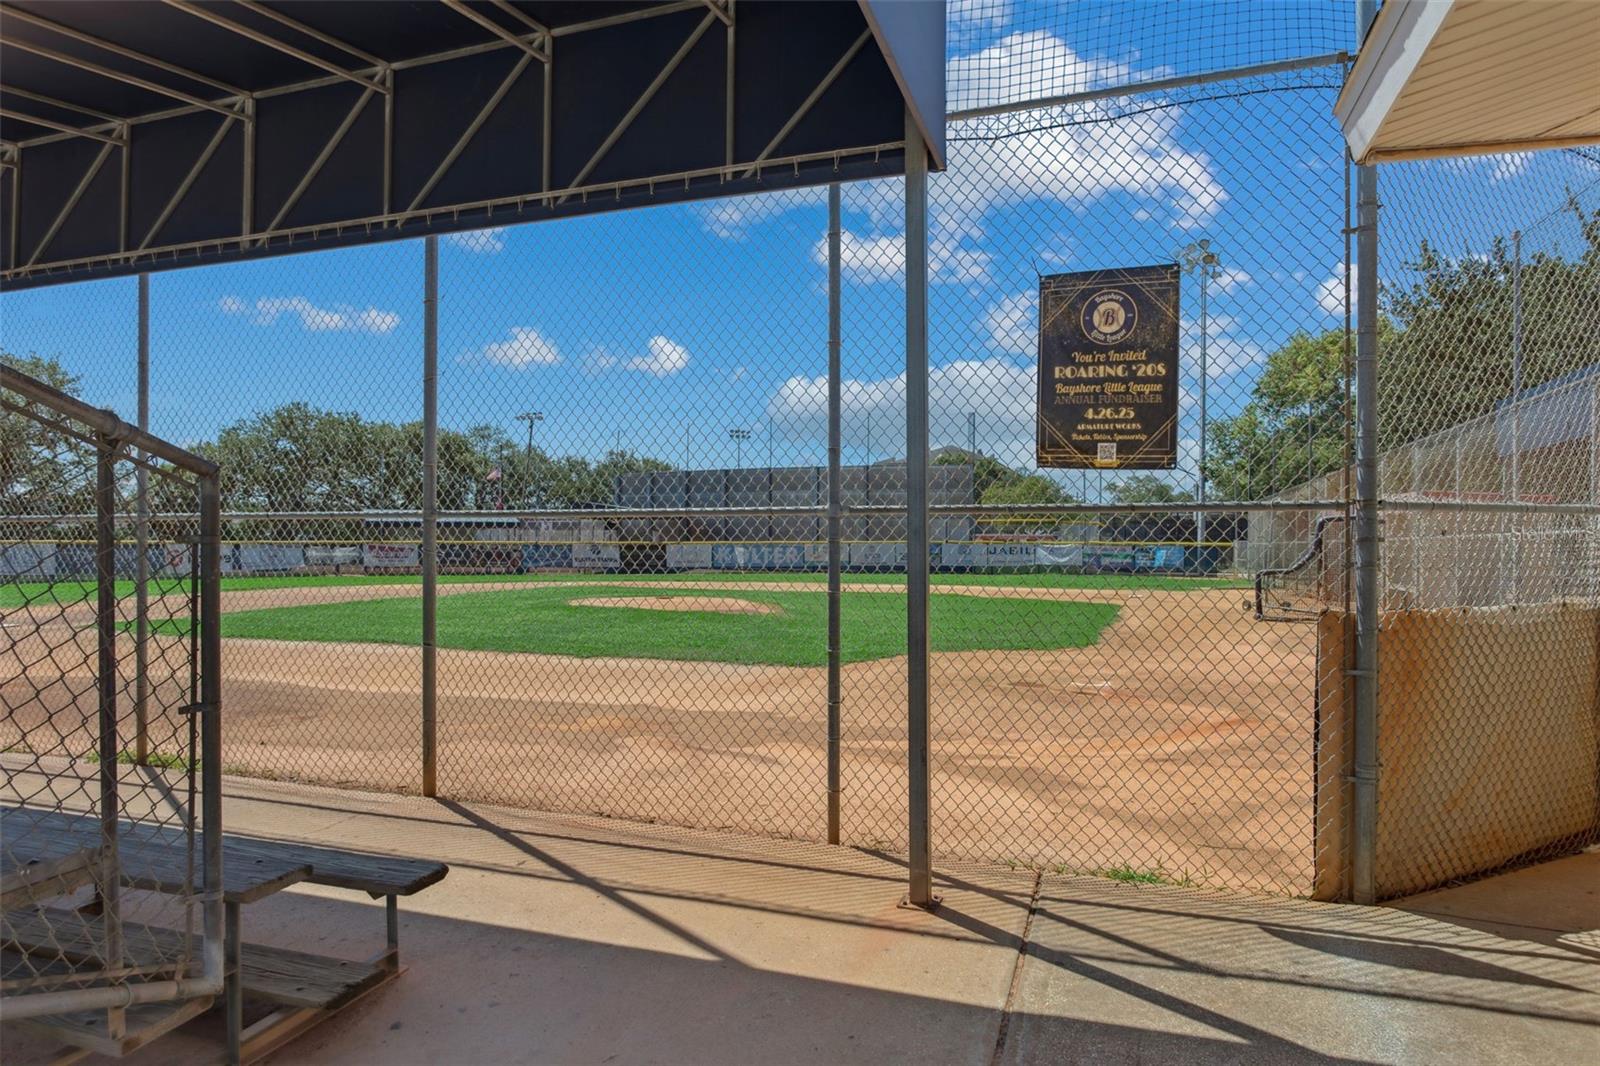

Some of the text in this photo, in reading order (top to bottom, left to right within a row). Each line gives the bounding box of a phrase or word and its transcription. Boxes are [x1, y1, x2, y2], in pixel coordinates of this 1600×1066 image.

[1103, 308, 1115, 326] B
[1071, 350, 1148, 362] You're Invited
[1055, 365, 1129, 379] ROARING
[1055, 381, 1163, 396] Bayshore Little League
[1054, 394, 1163, 405] ANNUAL FUNDRAISER
[1083, 407, 1136, 420] 4.26.25
